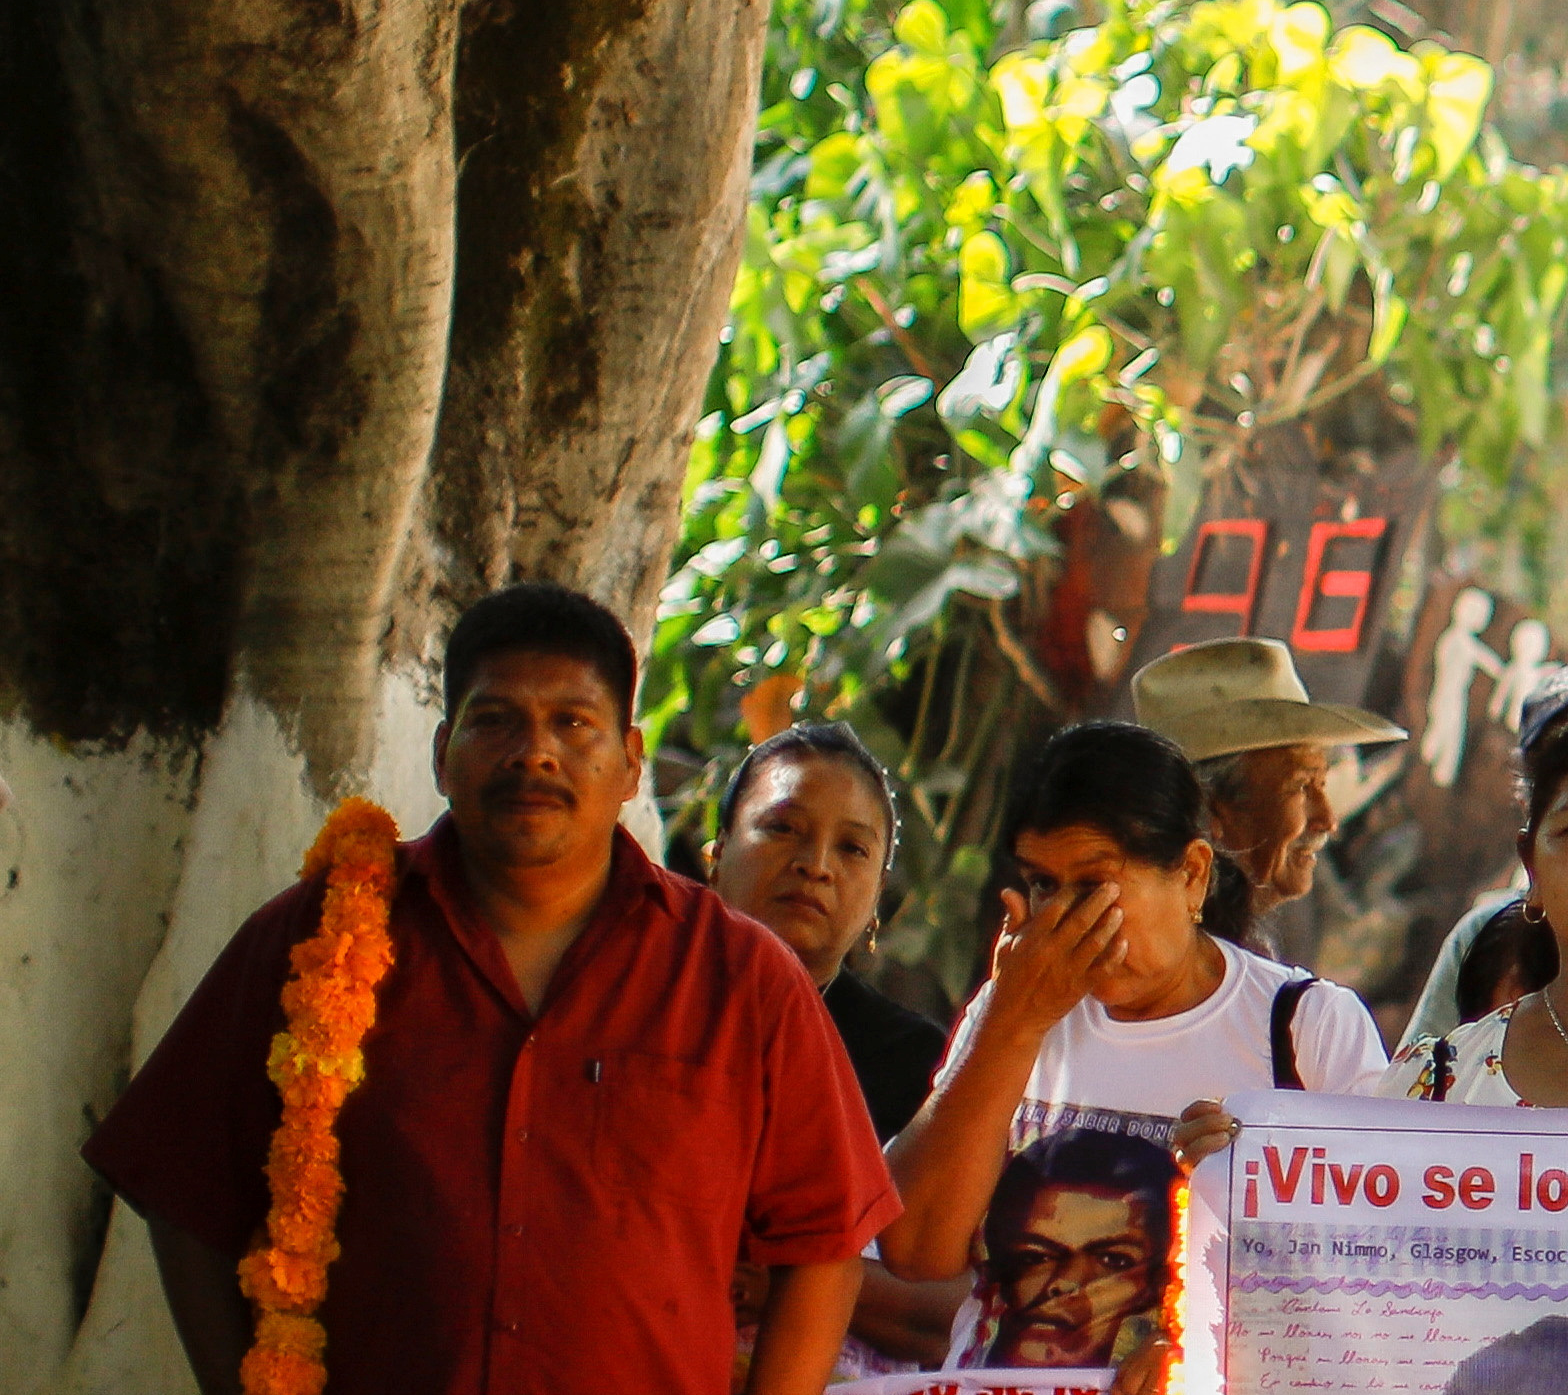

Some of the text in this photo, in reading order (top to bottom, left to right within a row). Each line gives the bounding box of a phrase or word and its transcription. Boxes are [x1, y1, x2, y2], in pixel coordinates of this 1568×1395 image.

[1126, 1119, 1172, 1141] DON
[1244, 1146, 1400, 1218] ¡Vivo
[1422, 1165, 1495, 1210] se
[1243, 1239, 1272, 1257] Yo,
[1288, 1241, 1321, 1255] Jan
[1333, 1242, 1396, 1261] Nimmo,
[1410, 1244, 1498, 1264] Glasgow,
